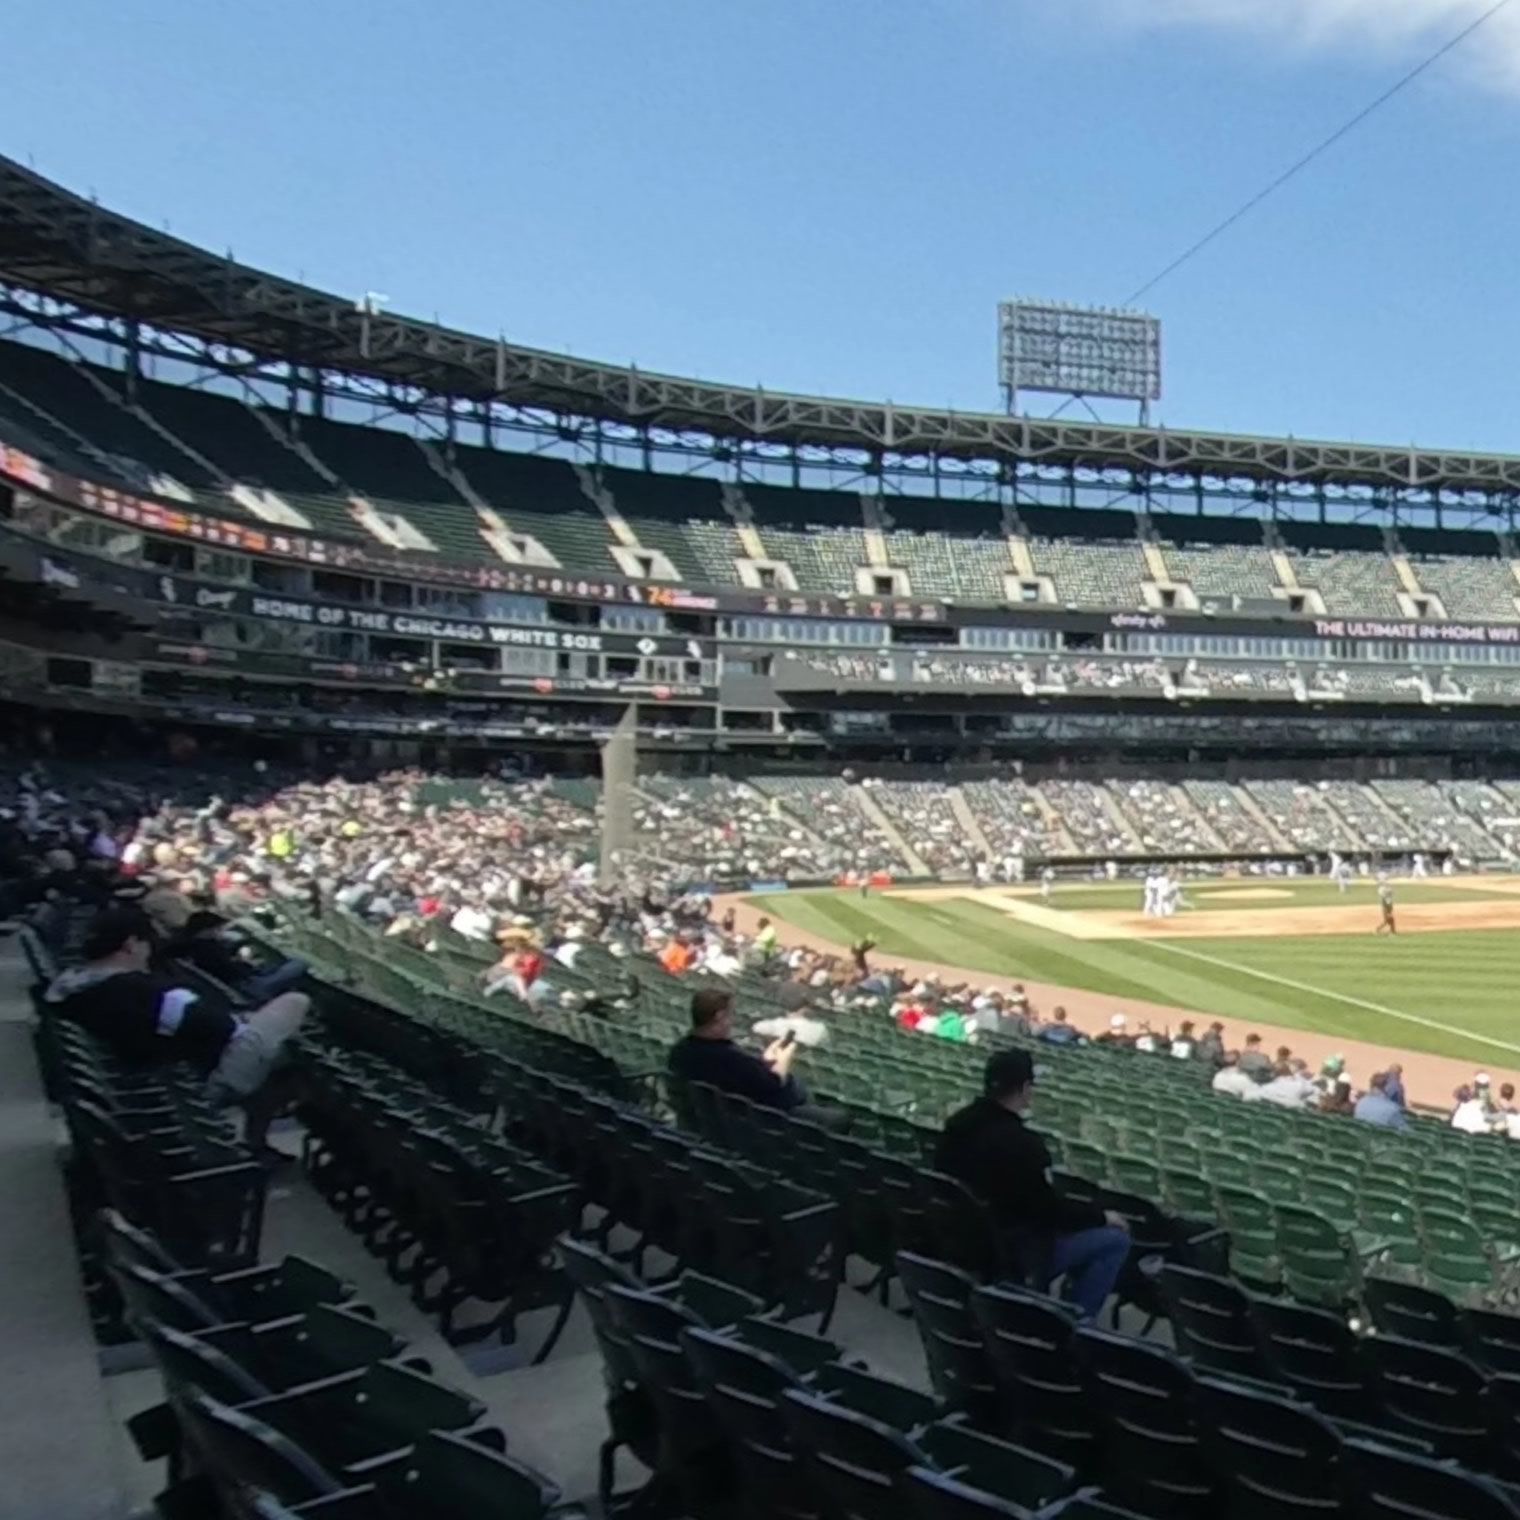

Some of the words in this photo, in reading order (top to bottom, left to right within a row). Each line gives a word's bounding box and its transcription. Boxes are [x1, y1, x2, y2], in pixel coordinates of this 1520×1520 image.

[252, 598, 313, 622] HOME
[316, 607, 345, 625] OF
[350, 610, 390, 631] THE
[393, 616, 485, 641] CHICAGO
[488, 626, 558, 648] WHITE
[561, 633, 603, 650] SOX
[1315, 620, 1345, 637] THE
[1347, 622, 1417, 638] ULTIMATE
[1419, 624, 1486, 641] IN-HOME
